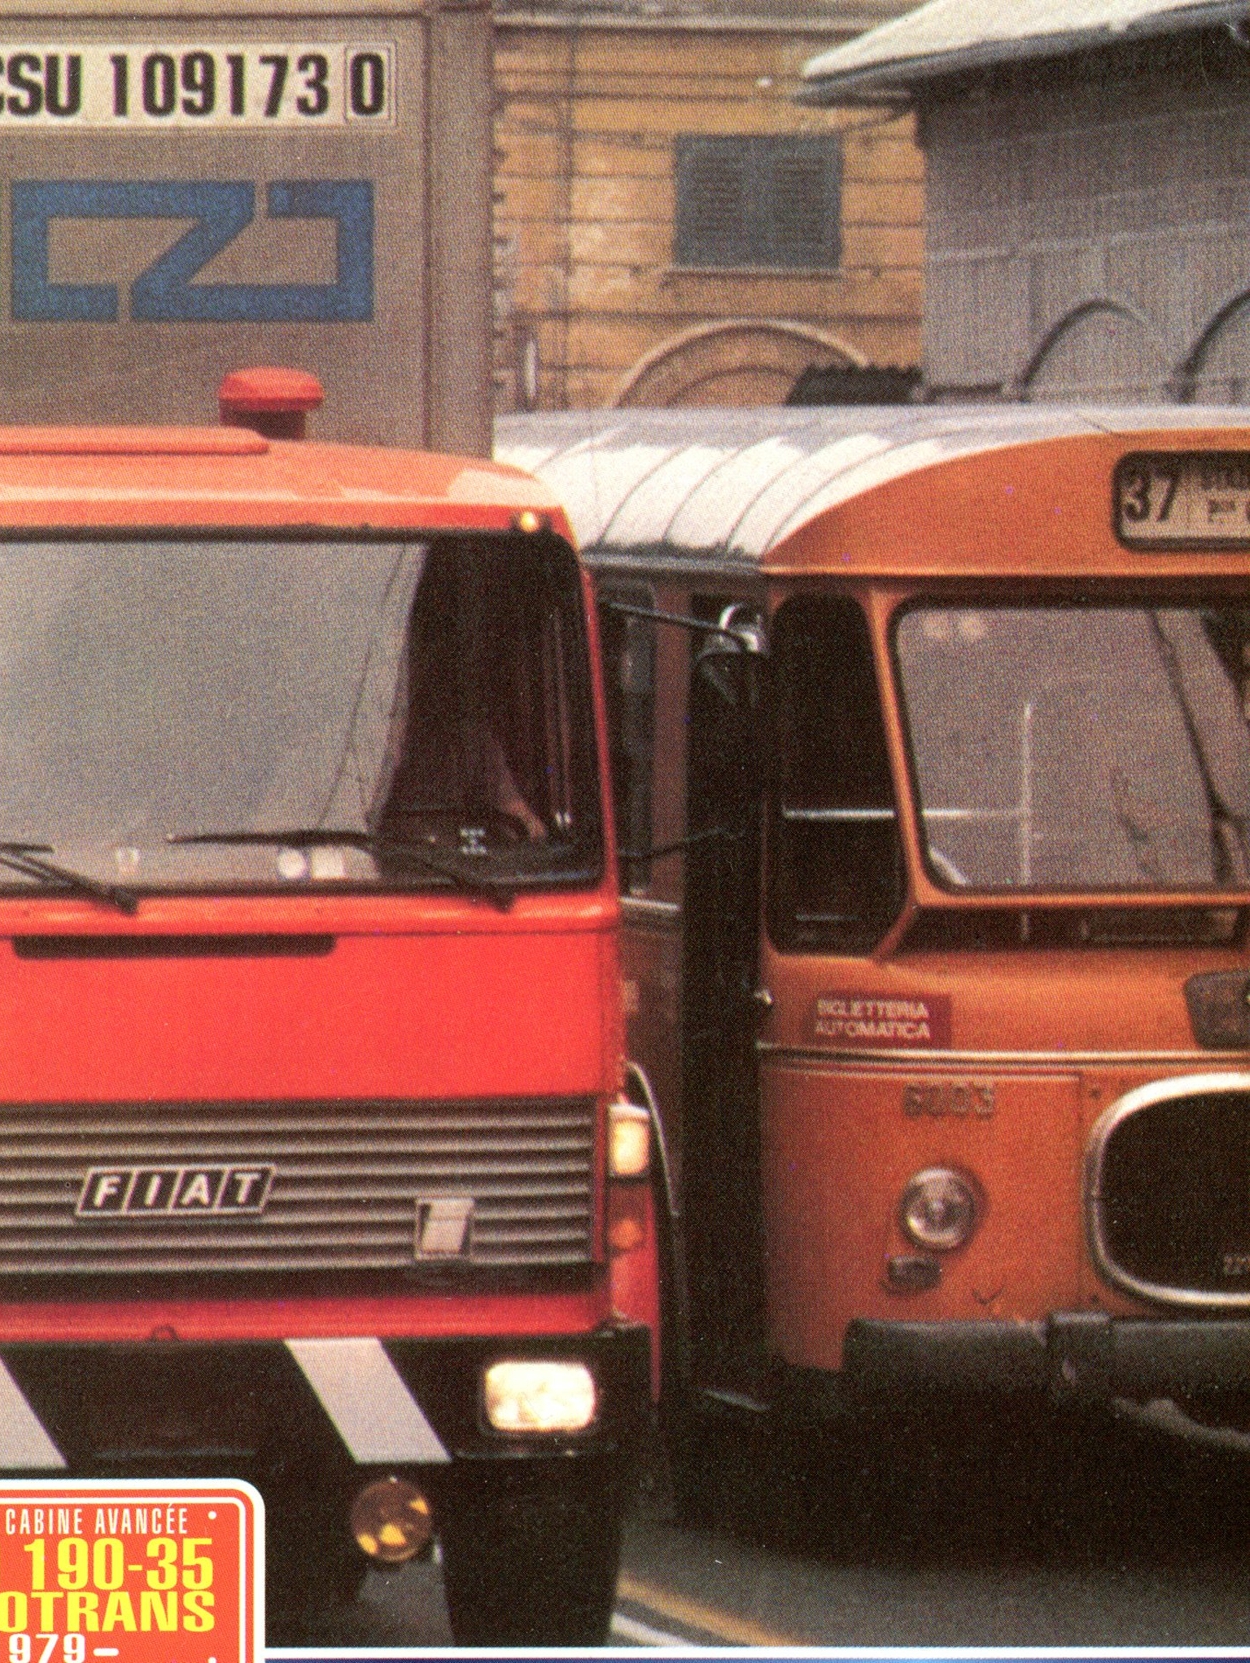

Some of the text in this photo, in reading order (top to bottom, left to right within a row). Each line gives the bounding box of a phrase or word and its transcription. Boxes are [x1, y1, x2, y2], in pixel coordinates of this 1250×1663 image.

[110, 51, 330, 117] 109173
[350, 52, 385, 117] 0
[1120, 464, 1181, 522] 37
[815, 1020, 930, 1039] AUTOMATICA
[93, 1172, 261, 1207] FIAT
